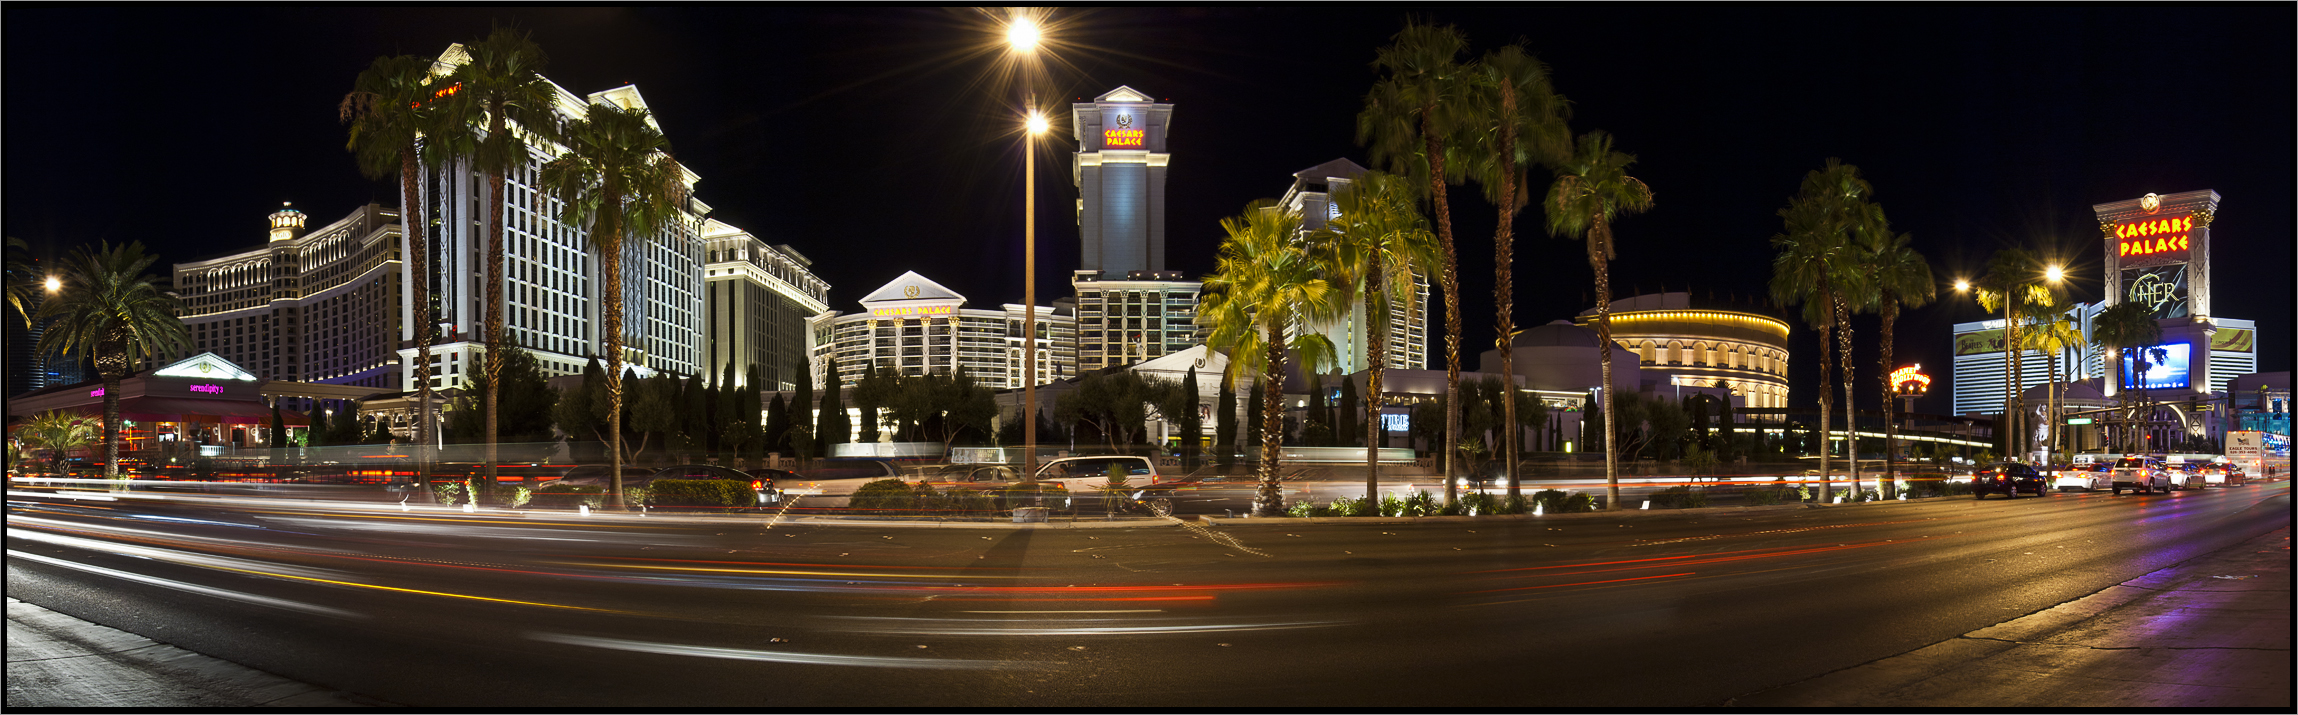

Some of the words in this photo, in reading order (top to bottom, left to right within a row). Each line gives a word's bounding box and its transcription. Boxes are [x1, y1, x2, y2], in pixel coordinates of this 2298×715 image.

[1104, 129, 1144, 138] CAESARS
[1106, 137, 1142, 146] PALACE
[2115, 216, 2193, 240] CAESARS
[2120, 234, 2189, 257] PALACE
[2129, 273, 2180, 315] CHER
[873, 307, 912, 317] CAESARS
[917, 304, 951, 315] PALACE
[189, 384, 219, 395] serendipity
[220, 386, 224, 394] 3
